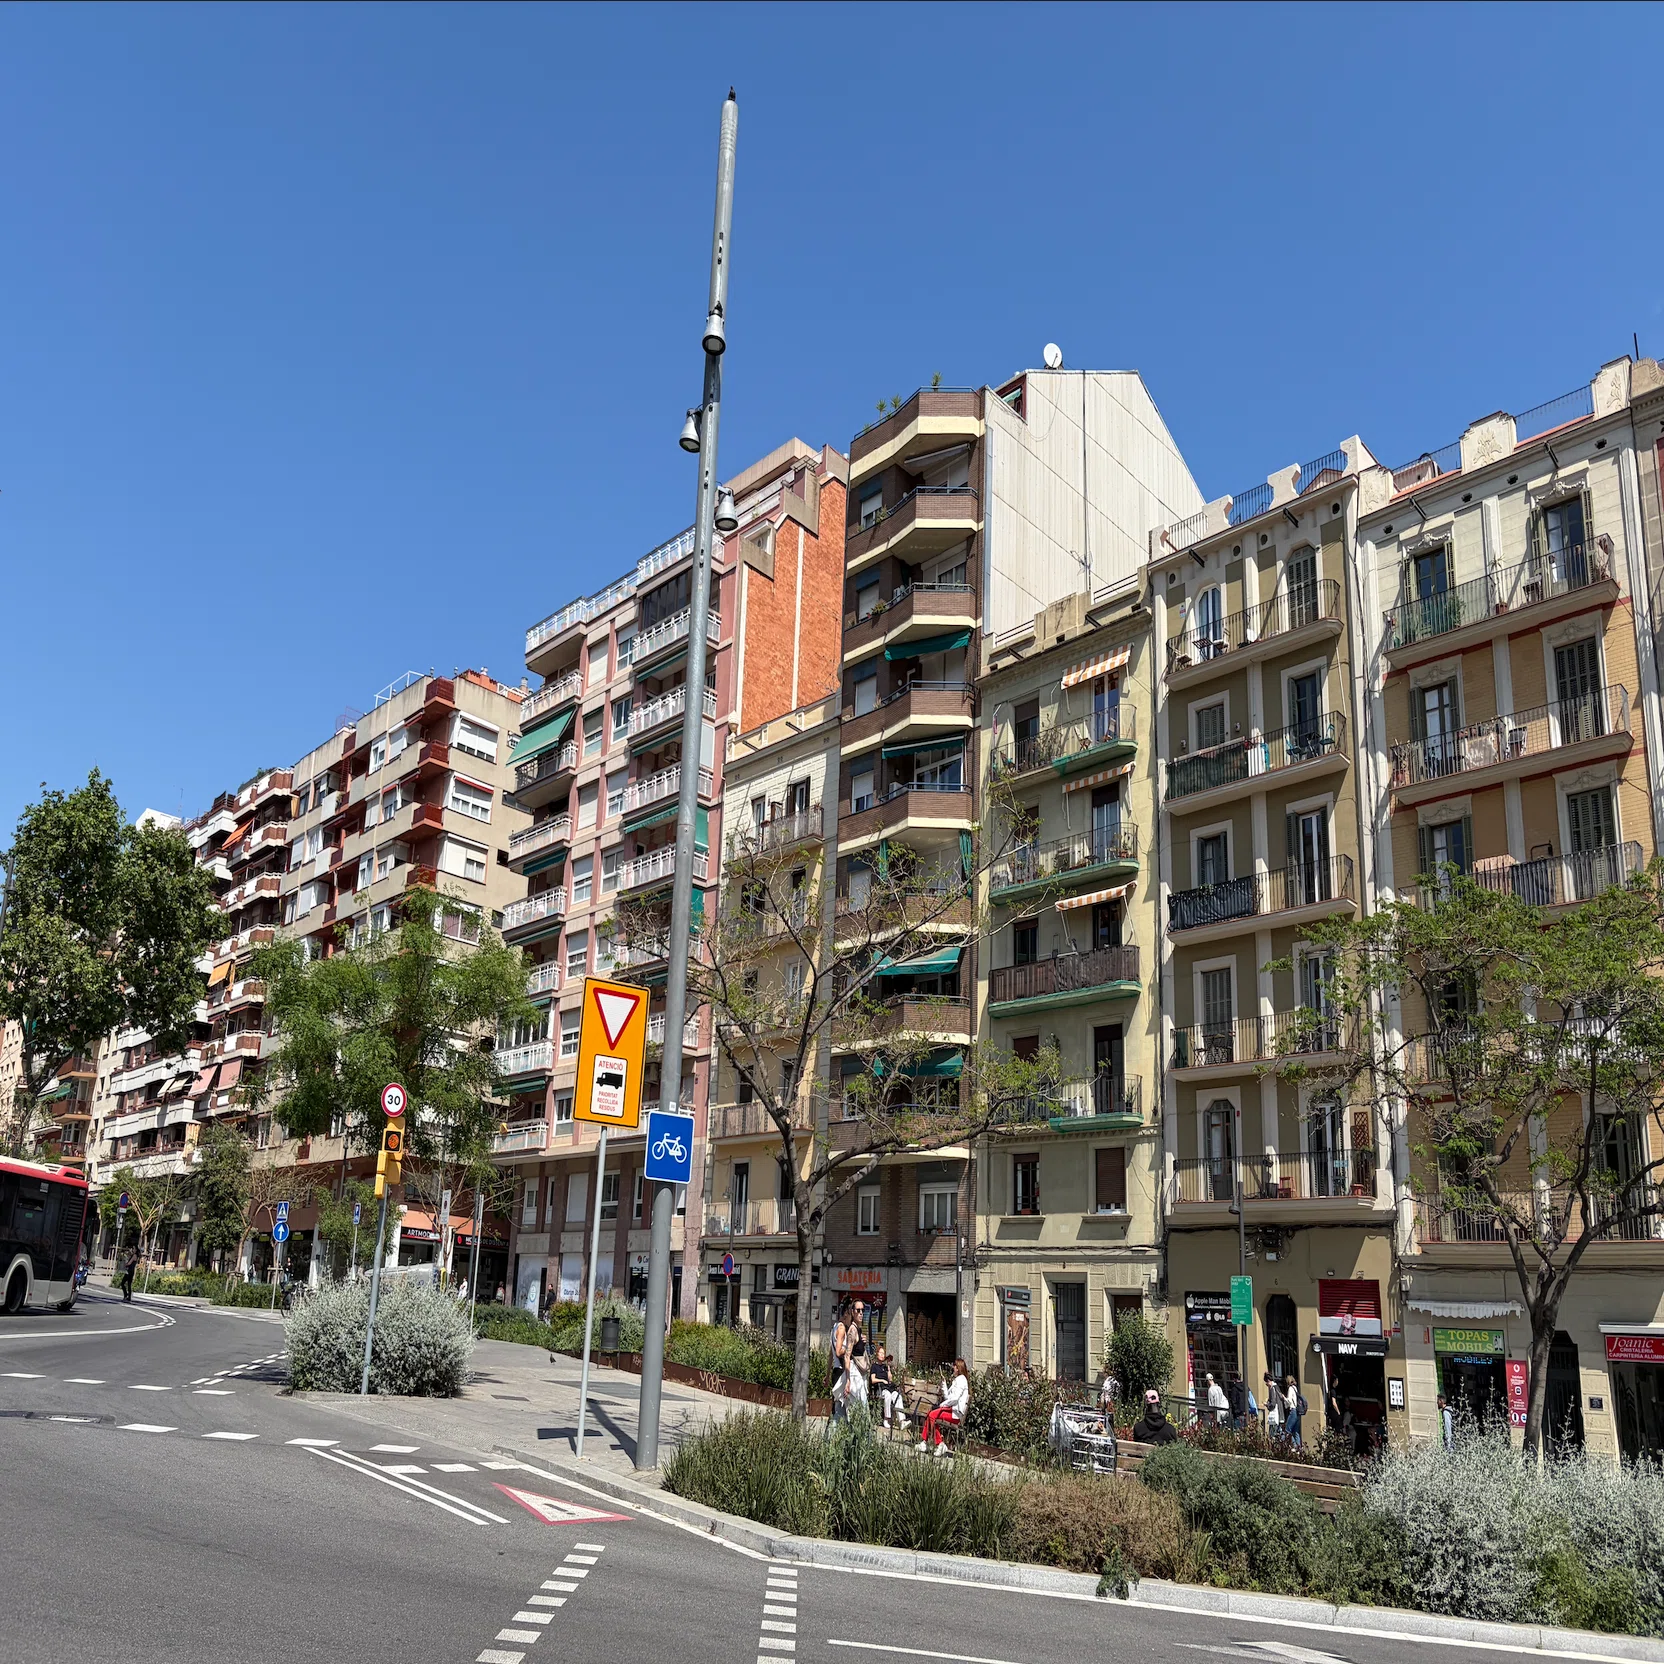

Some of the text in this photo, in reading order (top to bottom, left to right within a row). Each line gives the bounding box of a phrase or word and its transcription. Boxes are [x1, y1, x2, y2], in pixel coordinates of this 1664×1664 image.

[387, 1094, 401, 1106] 30
[837, 1270, 882, 1285] SABATERIA
[1194, 1297, 1208, 1305] Apple
[1208, 1297, 1218, 1305] Man
[1448, 1330, 1489, 1342] TOPAS
[1338, 1343, 1358, 1355] NAVY
[1609, 1337, 1654, 1353] Joanic
